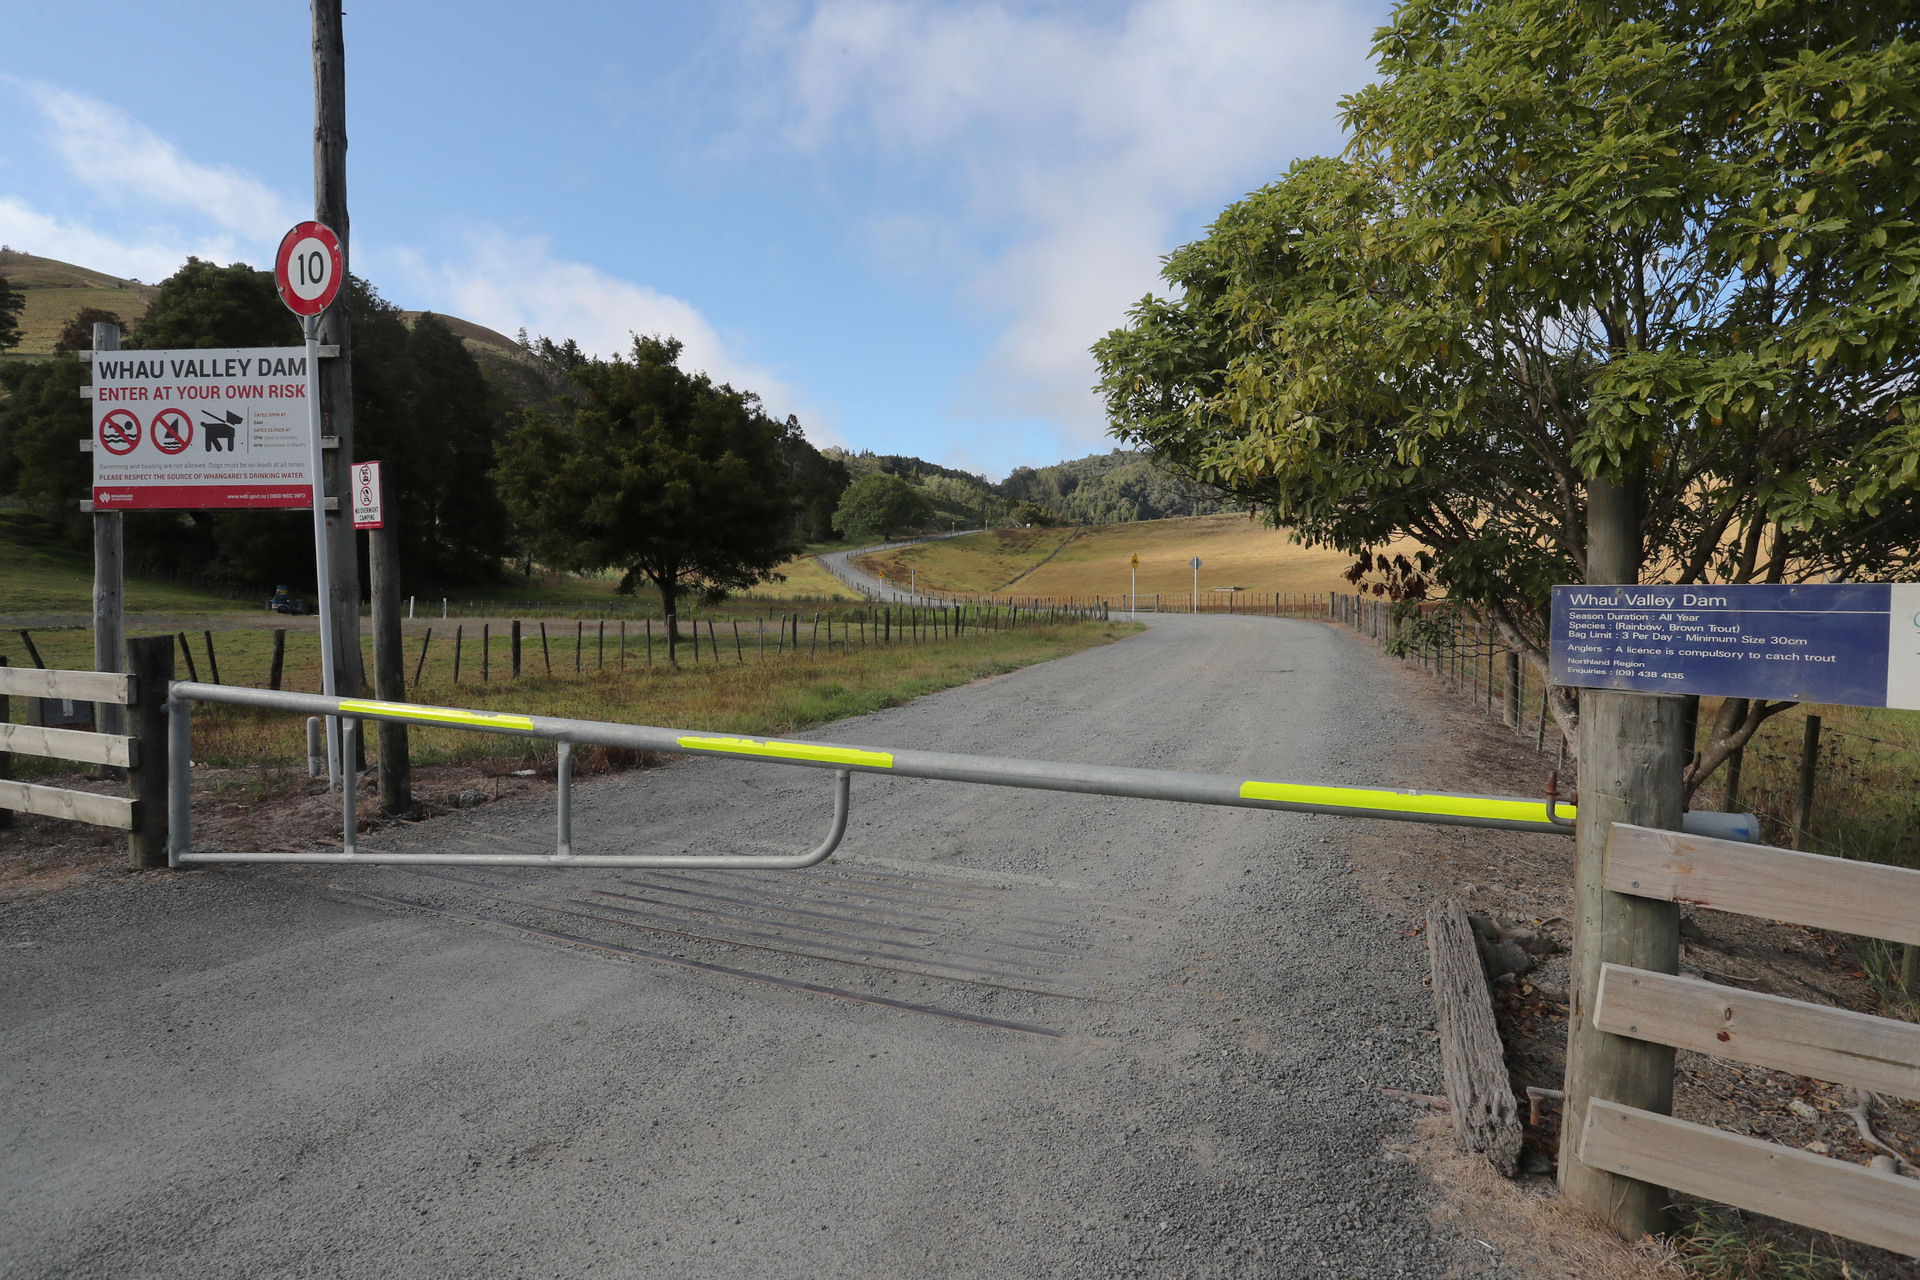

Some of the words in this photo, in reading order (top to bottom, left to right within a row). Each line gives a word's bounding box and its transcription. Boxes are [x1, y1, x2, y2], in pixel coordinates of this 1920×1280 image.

[298, 251, 324, 286] 10
[99, 360, 164, 379] WHAU
[170, 358, 252, 378] VALLEY
[258, 357, 306, 376] DAM
[100, 387, 149, 401] ENTER
[153, 386, 172, 400] AT
[176, 385, 220, 400] YOUR
[226, 384, 264, 398] OWN
[268, 384, 306, 398] RISK
[1570, 594, 1618, 606] Whau
[1625, 594, 1675, 609] Valley
[1683, 594, 1727, 607] Dam
[1569, 612, 1604, 620] Season
[1607, 612, 1648, 621] Duration
[1569, 622, 1605, 631] Species
[1615, 622, 1665, 632] (Rainbow,
[1669, 624, 1704, 632] Brown
[1708, 624, 1740, 634] Trout)
[1569, 631, 1586, 639] Bag
[1652, 633, 1673, 642] Day
[1686, 634, 1736, 643] Minimum
[1741, 636, 1765, 644] Size
[1771, 637, 1807, 645] 30cm
[1567, 644, 1602, 653] Anglers
[1627, 646, 1661, 655] licence
[1666, 648, 1674, 656] is
[1678, 650, 1744, 660] compulsory
[1766, 652, 1800, 661] catch
[1804, 654, 1836, 662] trout
[1568, 658, 1610, 666] Northland
[1613, 660, 1645, 668] Region
